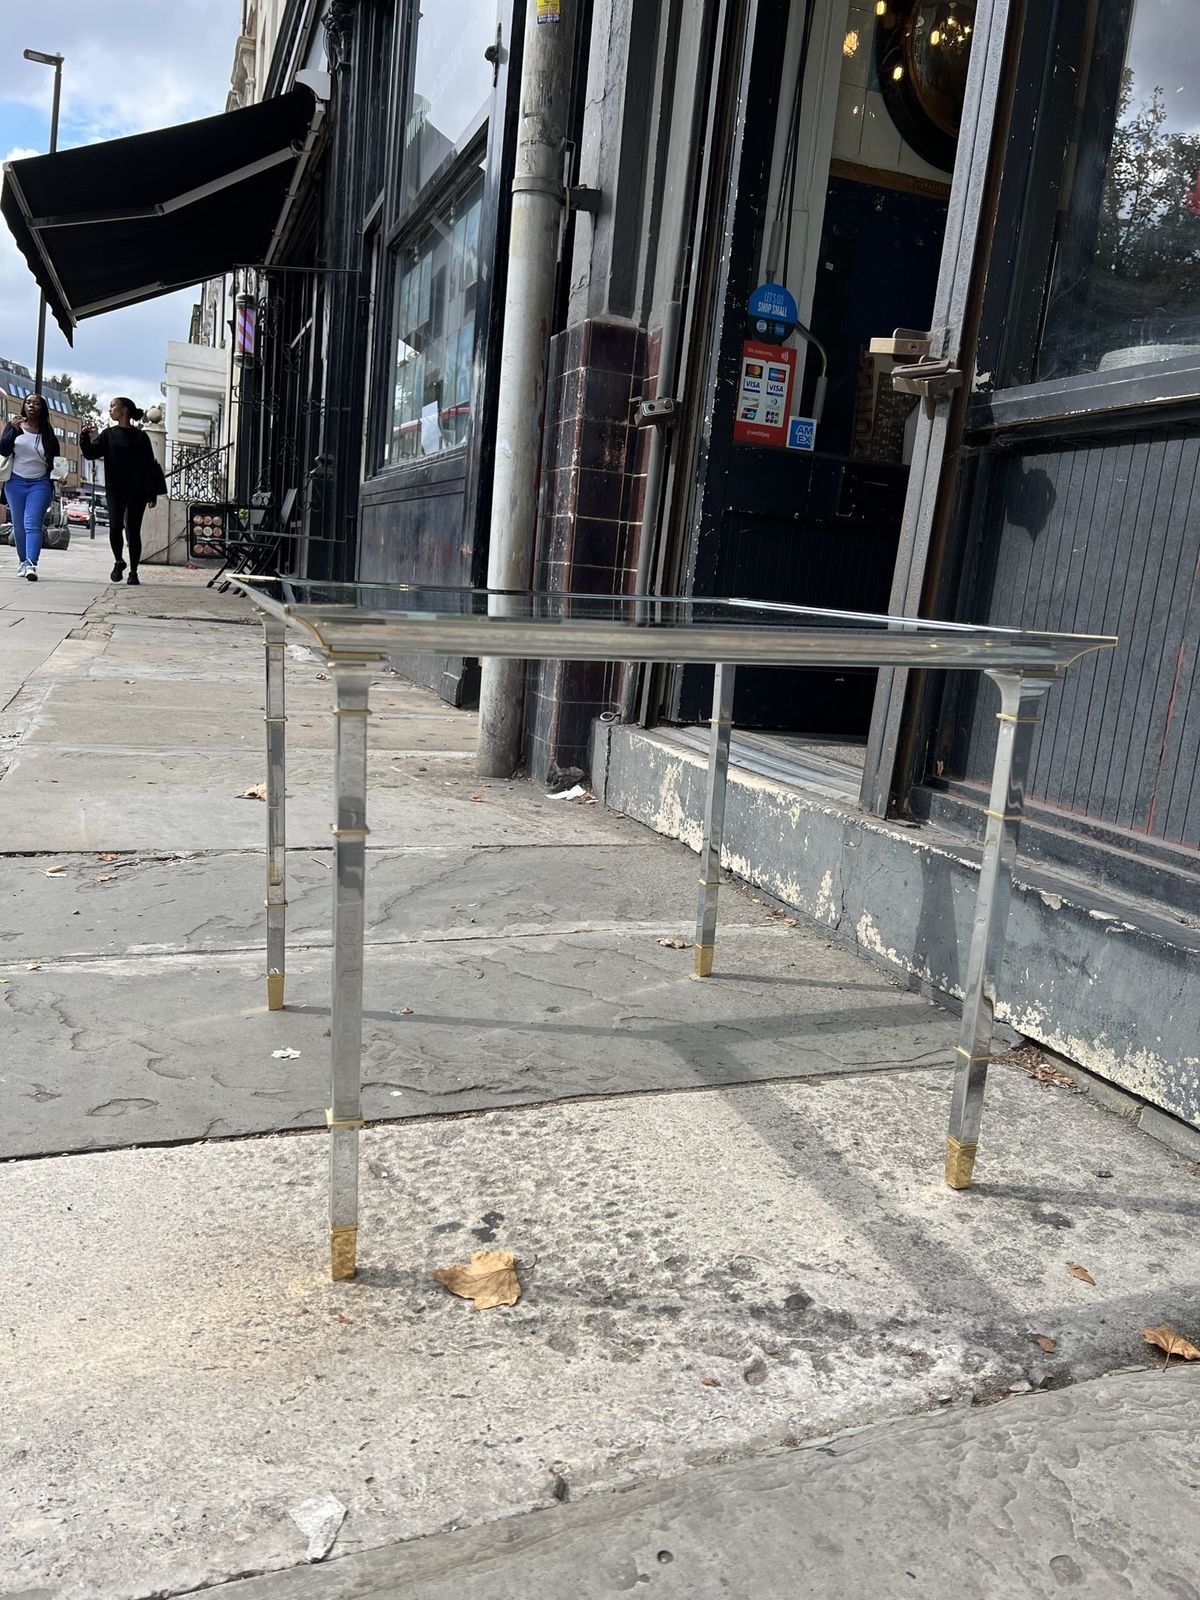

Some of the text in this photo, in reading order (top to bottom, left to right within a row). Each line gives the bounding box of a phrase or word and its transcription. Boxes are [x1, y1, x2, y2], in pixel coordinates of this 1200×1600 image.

[757, 301, 788, 317] SHOP SMALL
[746, 381, 760, 389] VISA
[769, 384, 784, 392] VISA
[795, 425, 813, 436] AM
[797, 434, 812, 445] EX
